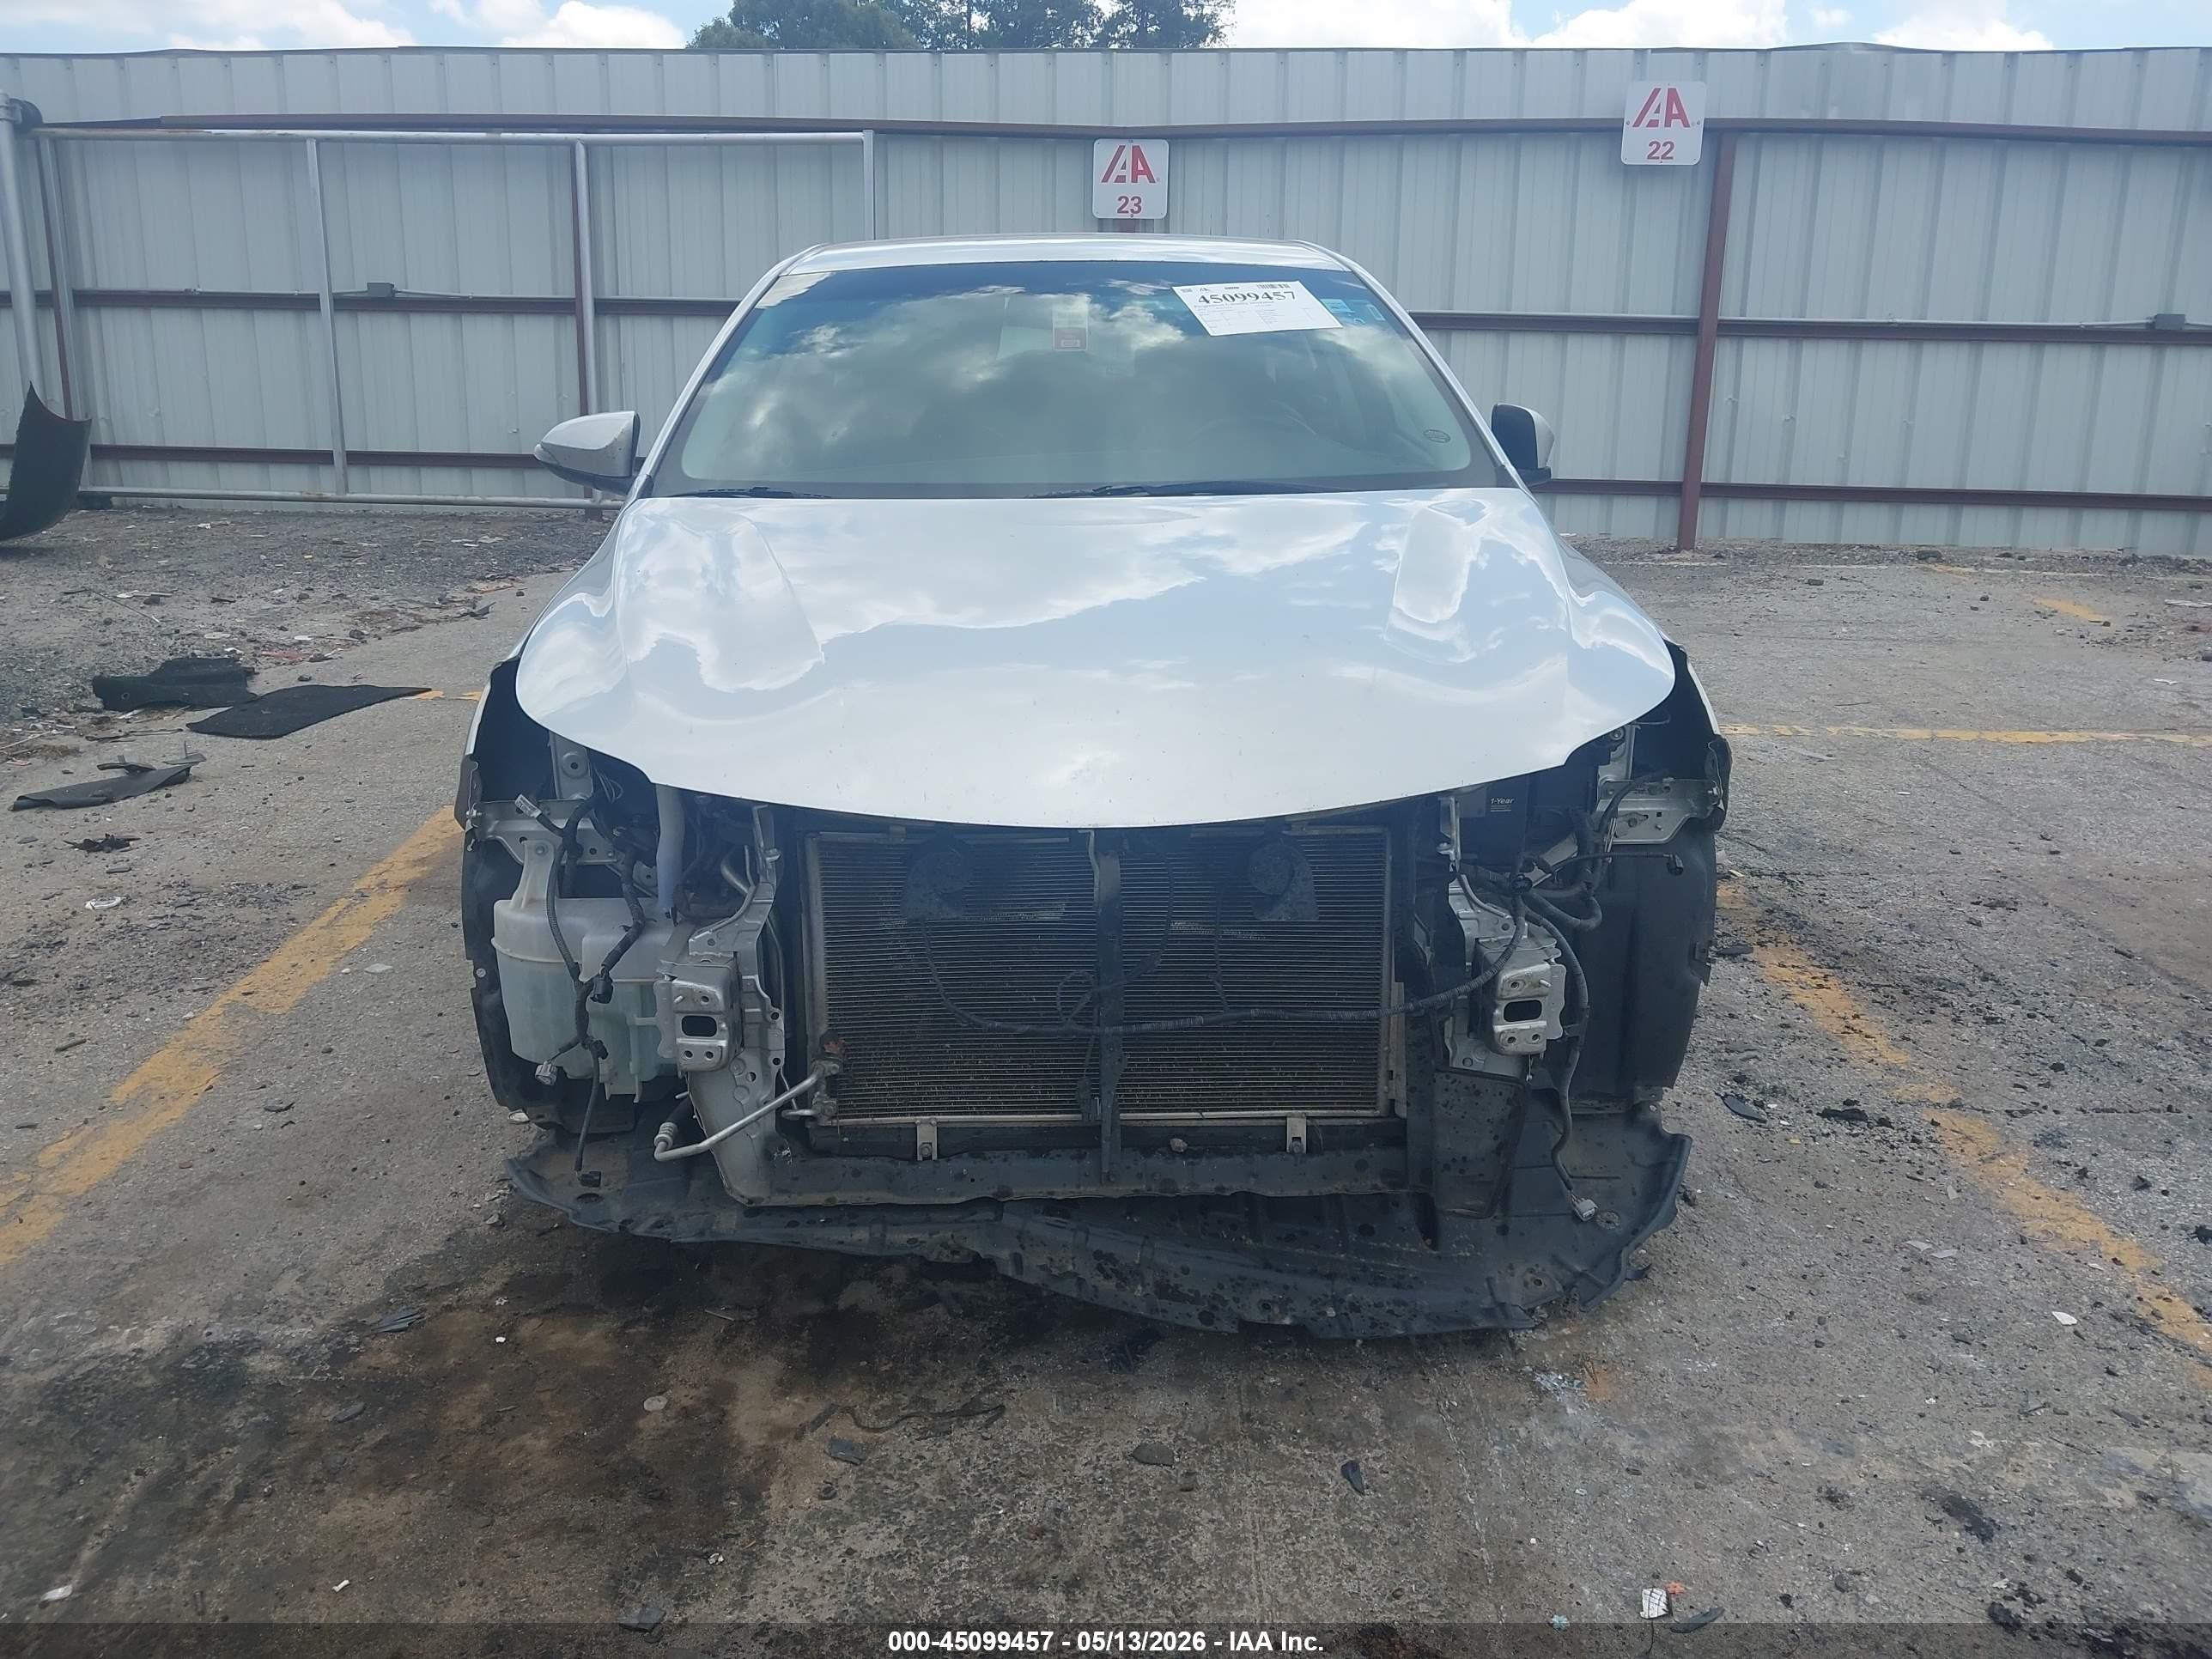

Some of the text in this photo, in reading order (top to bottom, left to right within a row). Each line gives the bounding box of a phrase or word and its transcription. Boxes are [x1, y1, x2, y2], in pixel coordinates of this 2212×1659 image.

[1647, 140, 1674, 160] 22
[1116, 196, 1142, 215] 23
[1198, 291, 1296, 305] 45099457
